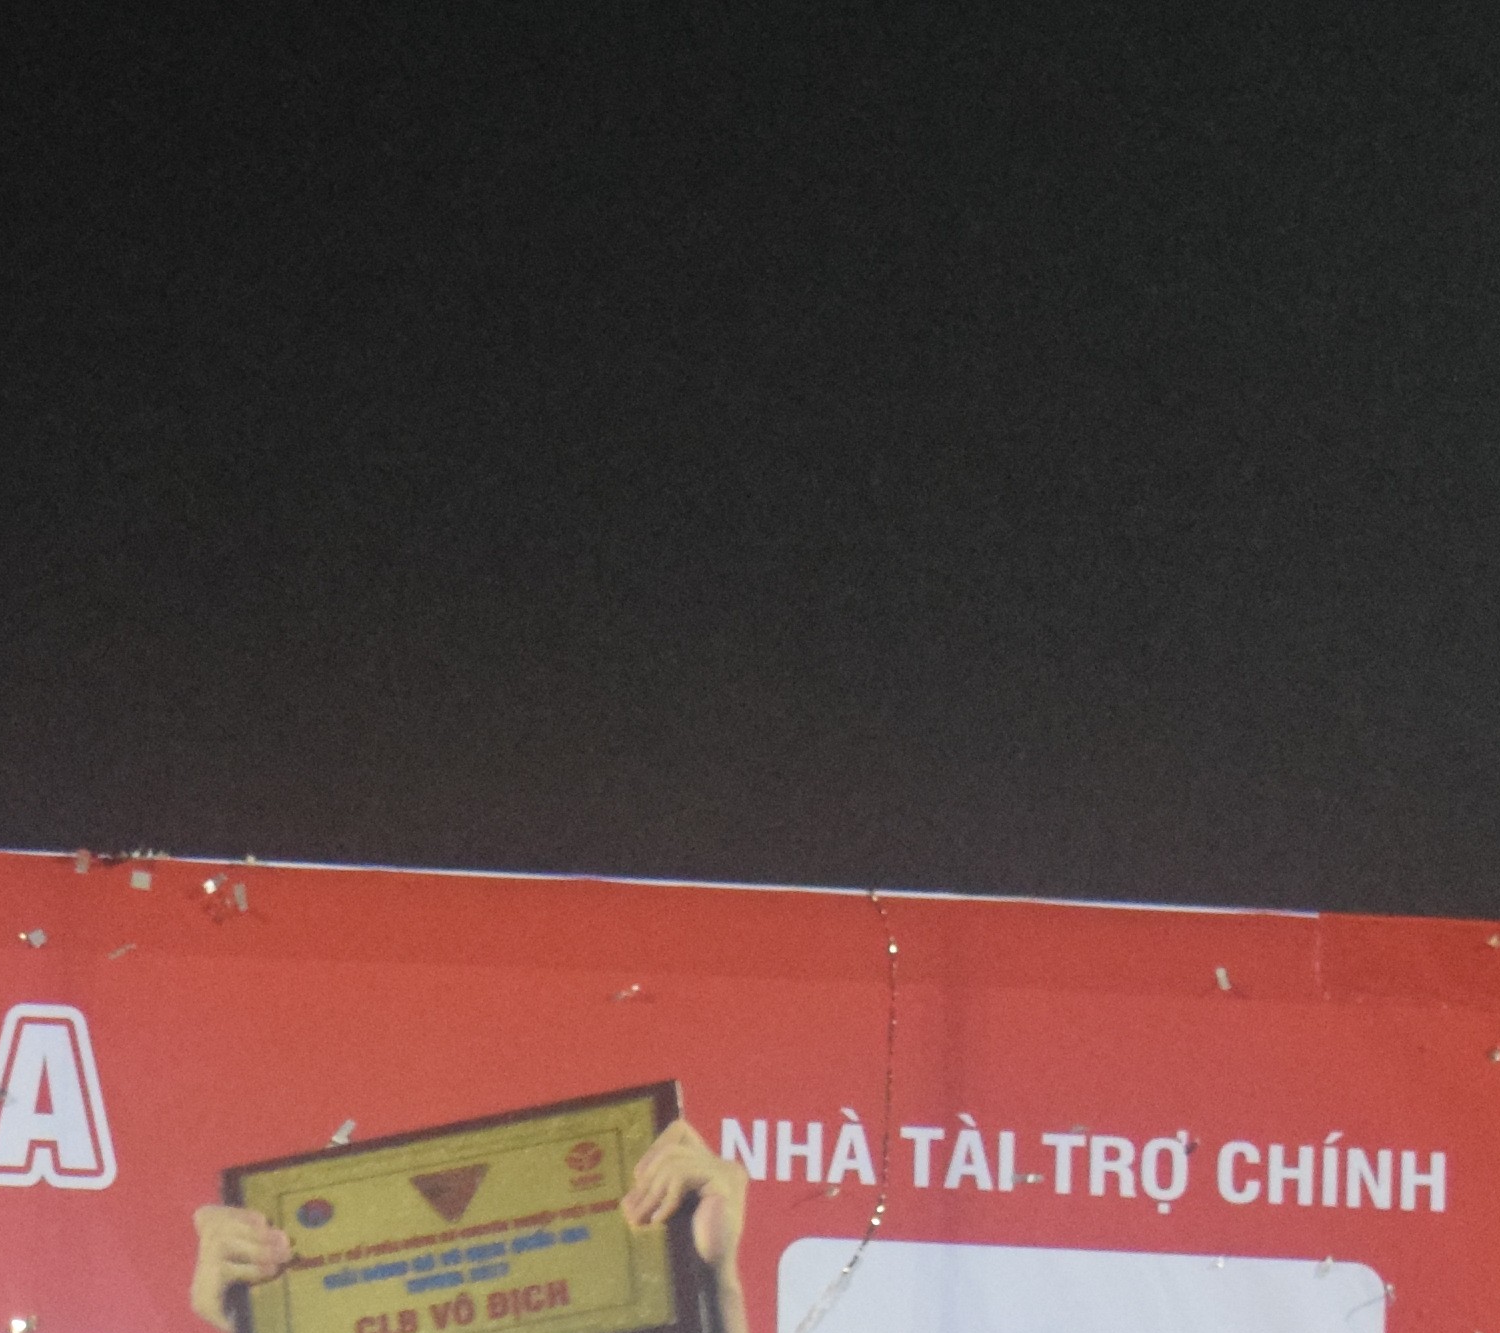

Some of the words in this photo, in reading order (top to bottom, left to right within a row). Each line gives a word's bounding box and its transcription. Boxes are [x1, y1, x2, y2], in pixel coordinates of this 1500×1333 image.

[720, 1106, 878, 1186] NHÀ
[900, 1114, 1014, 1193] TÀI
[1042, 1128, 1192, 1215] TRỢ
[1216, 1132, 1448, 1213] CHÍNH
